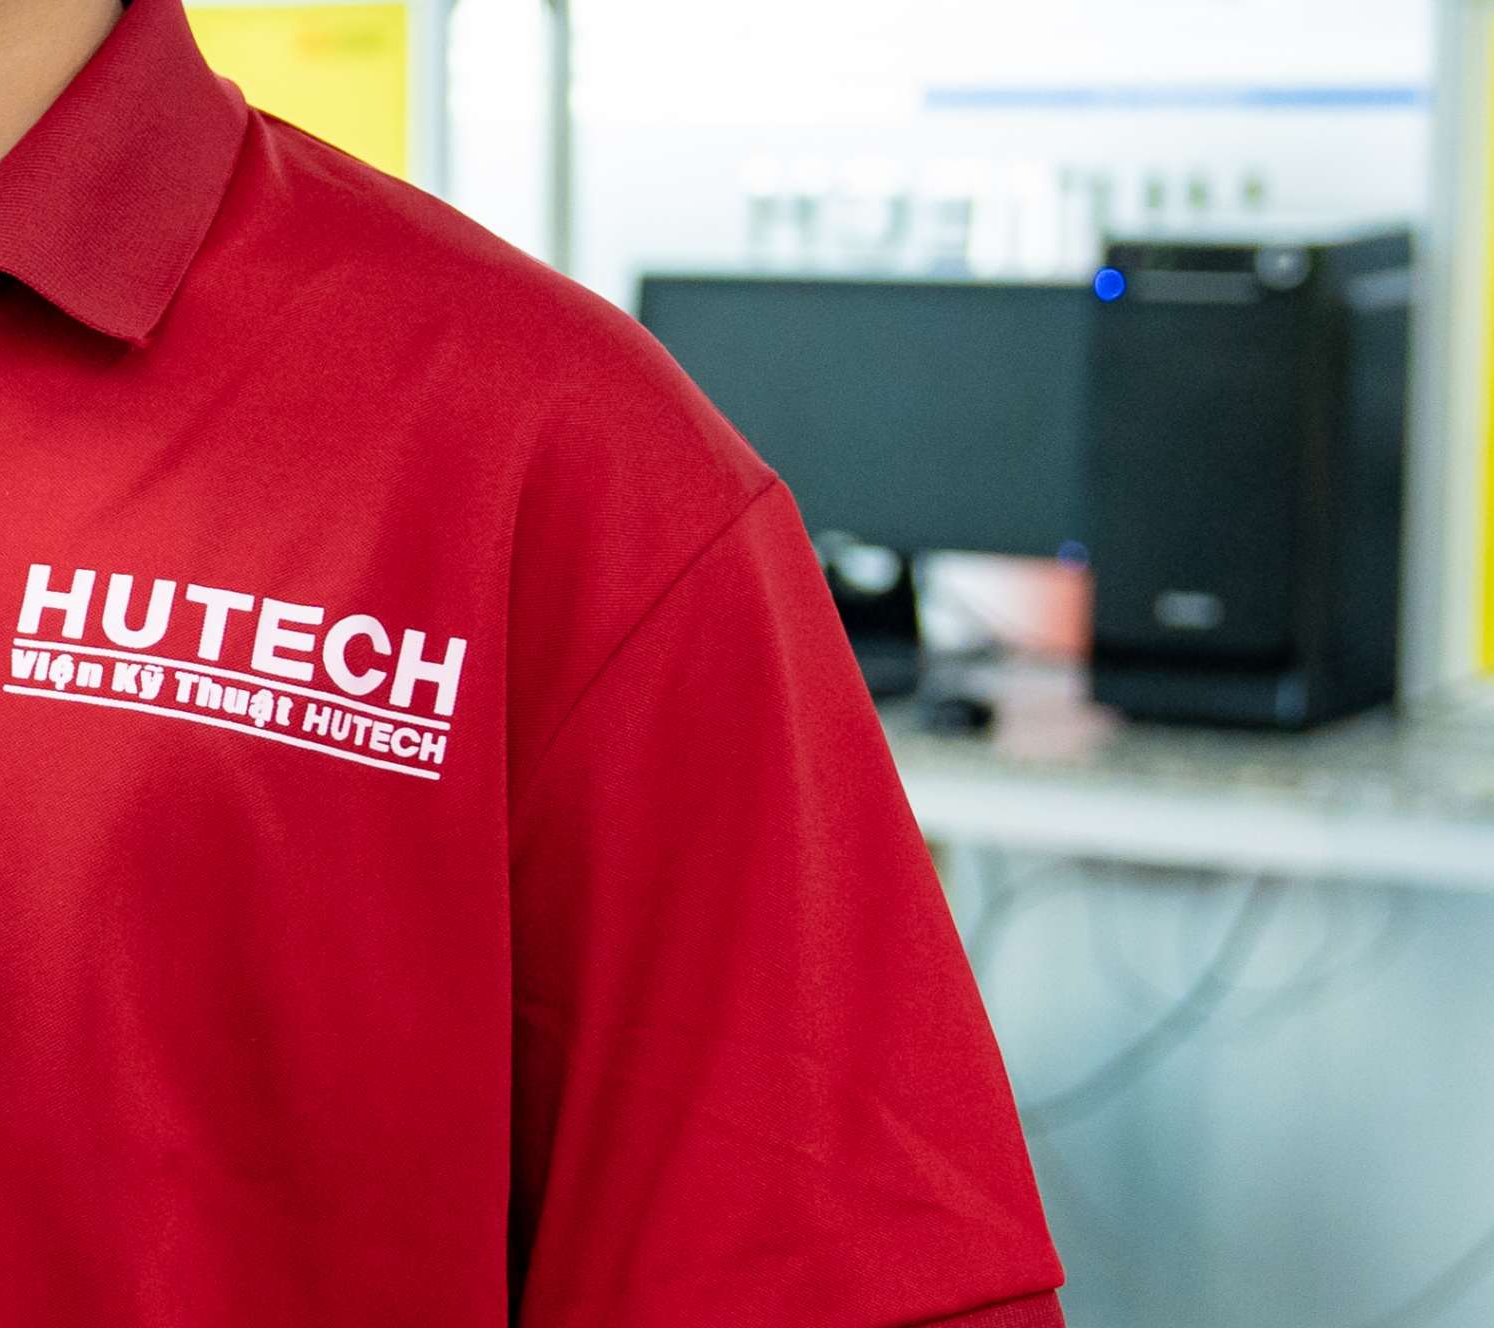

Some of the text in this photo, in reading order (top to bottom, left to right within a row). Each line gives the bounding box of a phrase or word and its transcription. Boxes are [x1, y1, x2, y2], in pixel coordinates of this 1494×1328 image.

[10, 647, 448, 765] Viện Kỹ Thuật HUTECH
[17, 564, 467, 716] HUTECH
